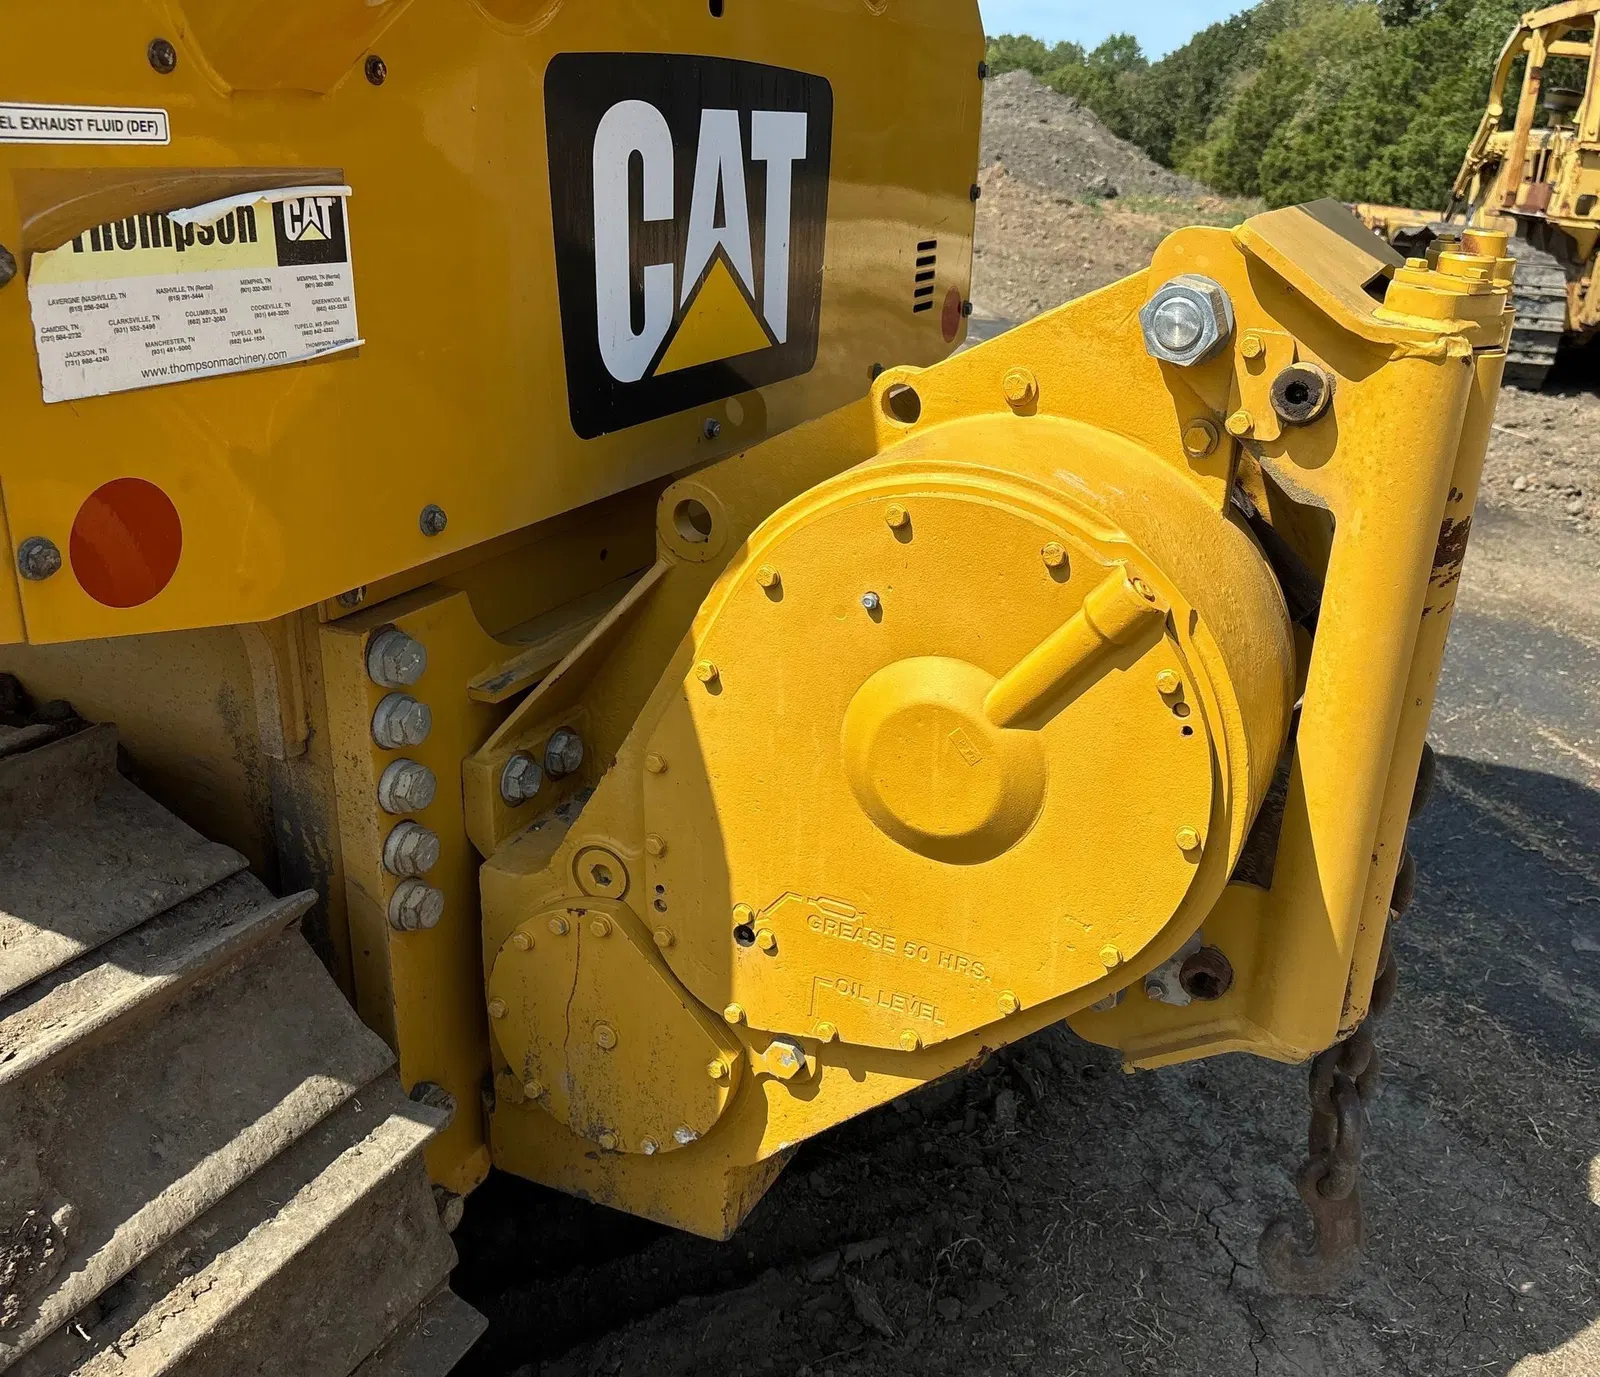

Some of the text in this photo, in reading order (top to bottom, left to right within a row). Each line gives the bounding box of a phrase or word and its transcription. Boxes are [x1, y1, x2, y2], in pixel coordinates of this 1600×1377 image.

[20, 117, 84, 131] EXHAUST
[87, 119, 124, 132] FLUID
[127, 120, 159, 136] (DEF)
[593, 99, 808, 383] CAT
[156, 286, 186, 294] NASHVILLE,
[48, 297, 80, 306] LAVERGNE
[312, 297, 342, 305] GREENWOOD,
[68, 305, 83, 314] (615)
[250, 303, 283, 312] COOKEVILLE,
[185, 309, 218, 317] COLUMBUS,
[108, 316, 150, 326] CLARKSVILLE,
[41, 325, 70, 334] CAMDEN,
[113, 326, 128, 334] (931)
[294, 322, 314, 330] TUPELO,
[230, 329, 253, 337] TUPELO,
[145, 338, 186, 348] MANCHESTER,
[305, 340, 332, 348] THOMPSON
[64, 349, 97, 358] JACKSON,
[151, 347, 166, 356] (931)
[64, 358, 80, 367] (731)
[141, 350, 288, 378] www.thompsonmachinery.com
[806, 914, 992, 984] GREASE 50 HRS.
[834, 978, 946, 1025] OIL LEVEL
